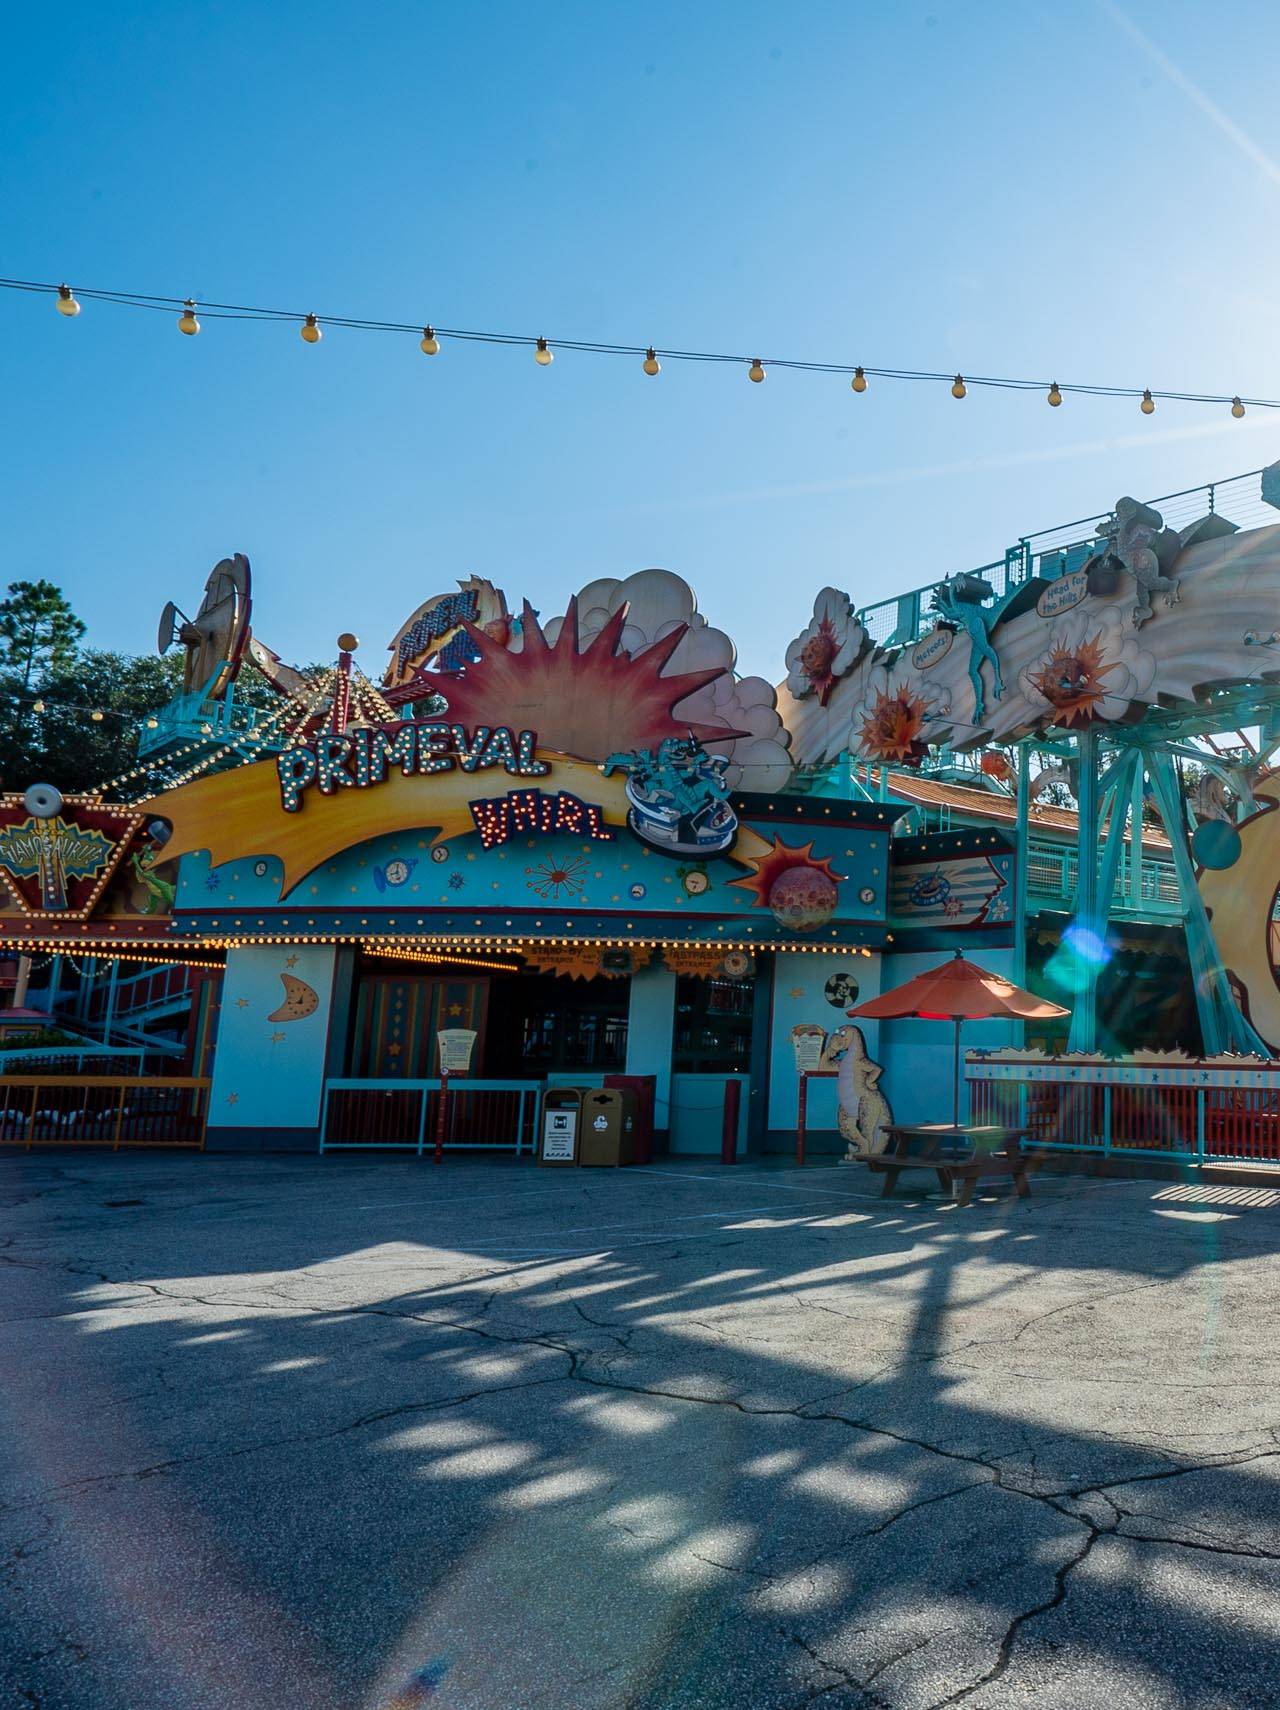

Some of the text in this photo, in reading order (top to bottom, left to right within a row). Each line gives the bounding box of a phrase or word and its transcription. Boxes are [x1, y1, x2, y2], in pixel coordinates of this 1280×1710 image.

[1043, 601, 1058, 614] the
[1047, 575, 1086, 600] Head for
[277, 721, 553, 814] PRIMEVAL
[469, 790, 615, 851] WHIRL
